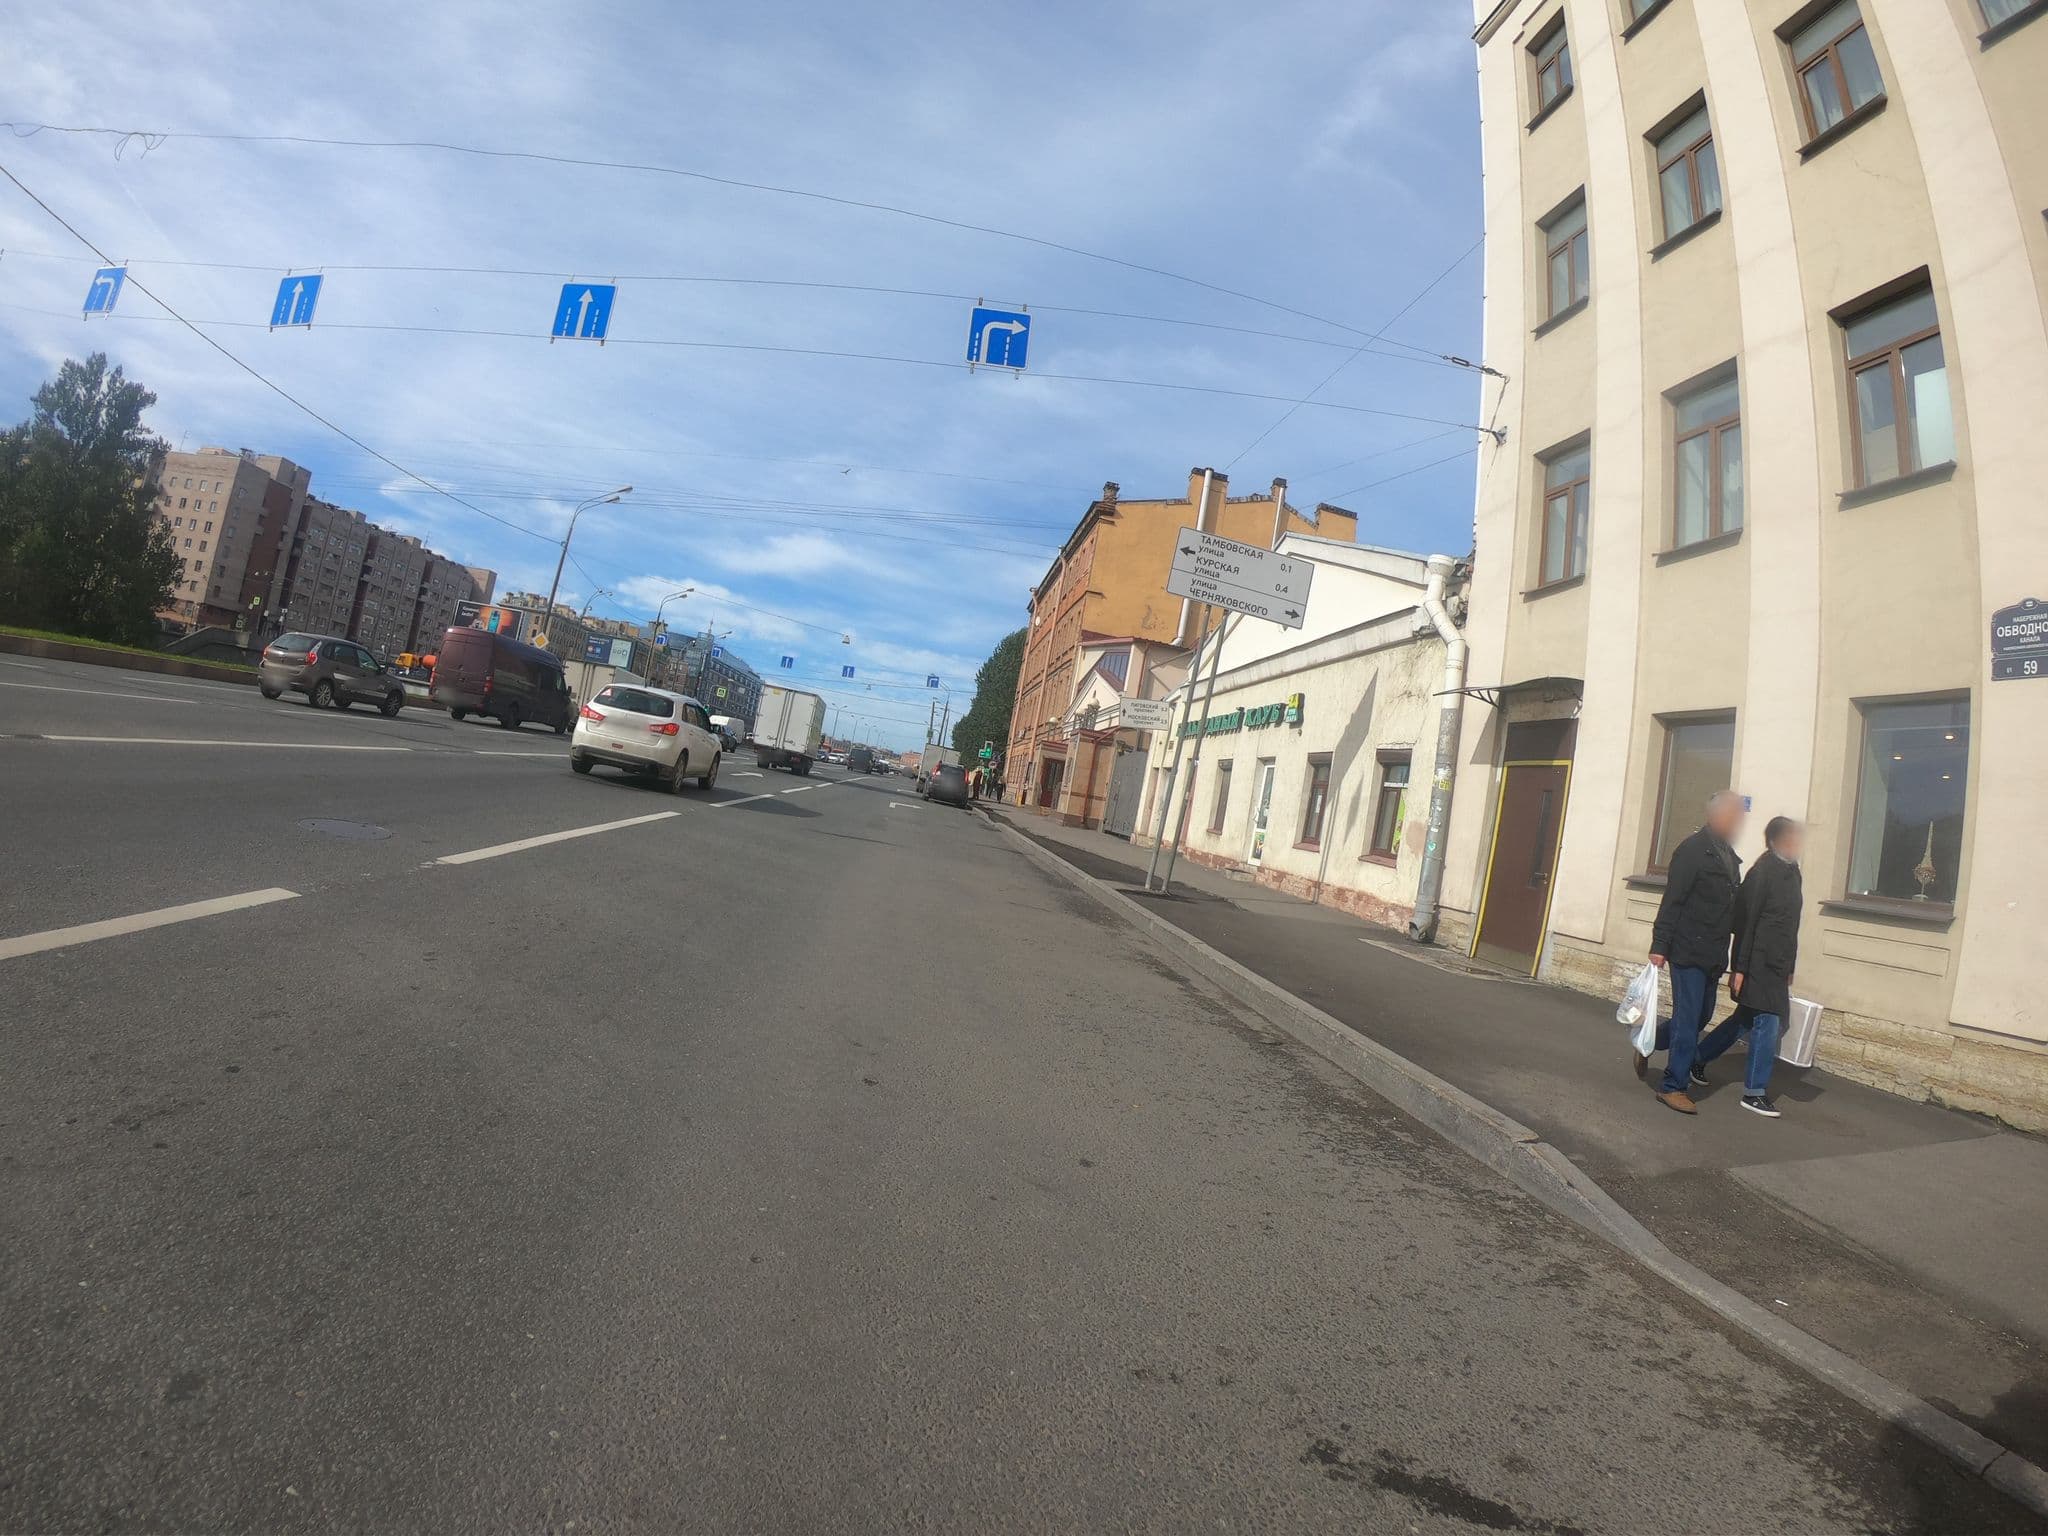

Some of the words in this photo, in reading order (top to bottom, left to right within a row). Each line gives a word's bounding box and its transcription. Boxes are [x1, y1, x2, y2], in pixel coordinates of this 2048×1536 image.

[1199, 545, 1225, 558] улица
[1200, 535, 1264, 560] ТАМБОВСКАЯ
[1194, 566, 1220, 579] улица
[1195, 556, 1240, 575] КУРСКАЯ
[1191, 578, 1218, 591] улица
[1189, 587, 1268, 616] ЧЕРНЯХОВСКОГО
[2023, 660, 2038, 675] 59
[1244, 703, 1281, 727] КЛУБ
